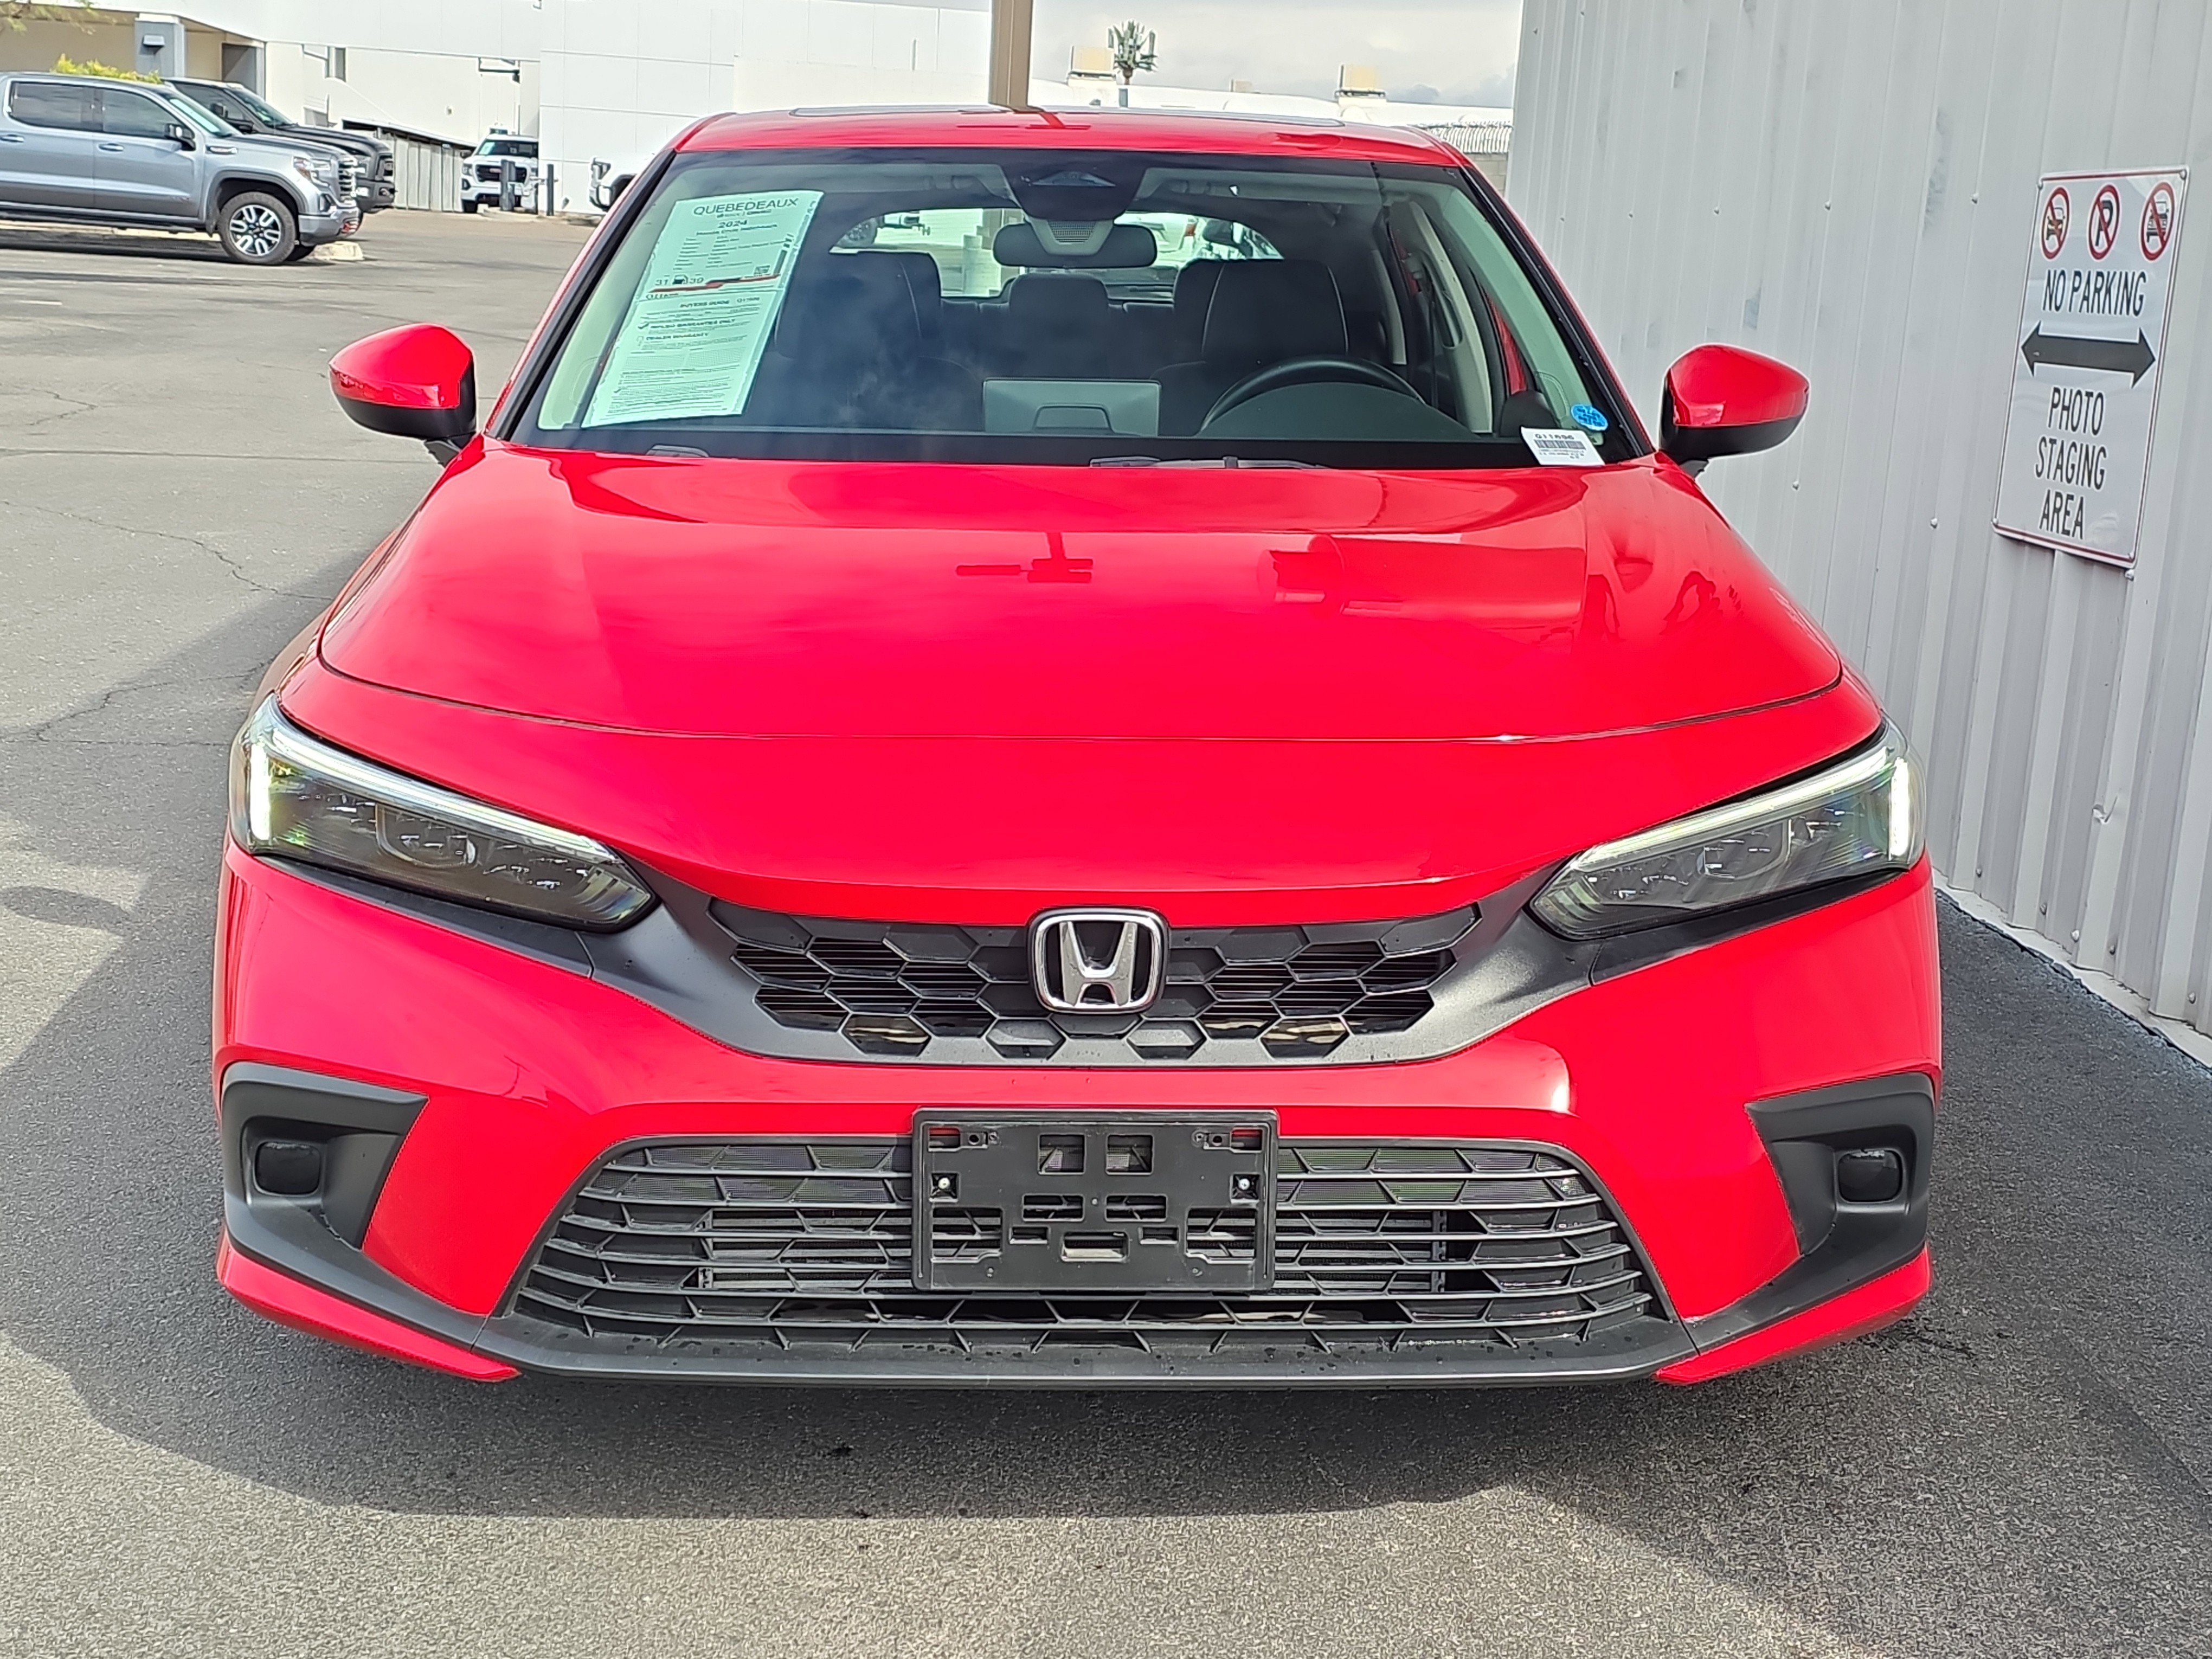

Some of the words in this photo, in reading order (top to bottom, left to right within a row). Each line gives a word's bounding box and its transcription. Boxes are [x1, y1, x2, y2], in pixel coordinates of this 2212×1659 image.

[693, 198, 799, 215] QUEBEDEAUX
[718, 220, 747, 228] 2024
[2043, 269, 2066, 312] NO
[2068, 271, 2146, 317] PARKING
[2048, 387, 2104, 435] PHOTO
[2035, 436, 2107, 490] STAGING
[2039, 490, 2085, 540] AREA
